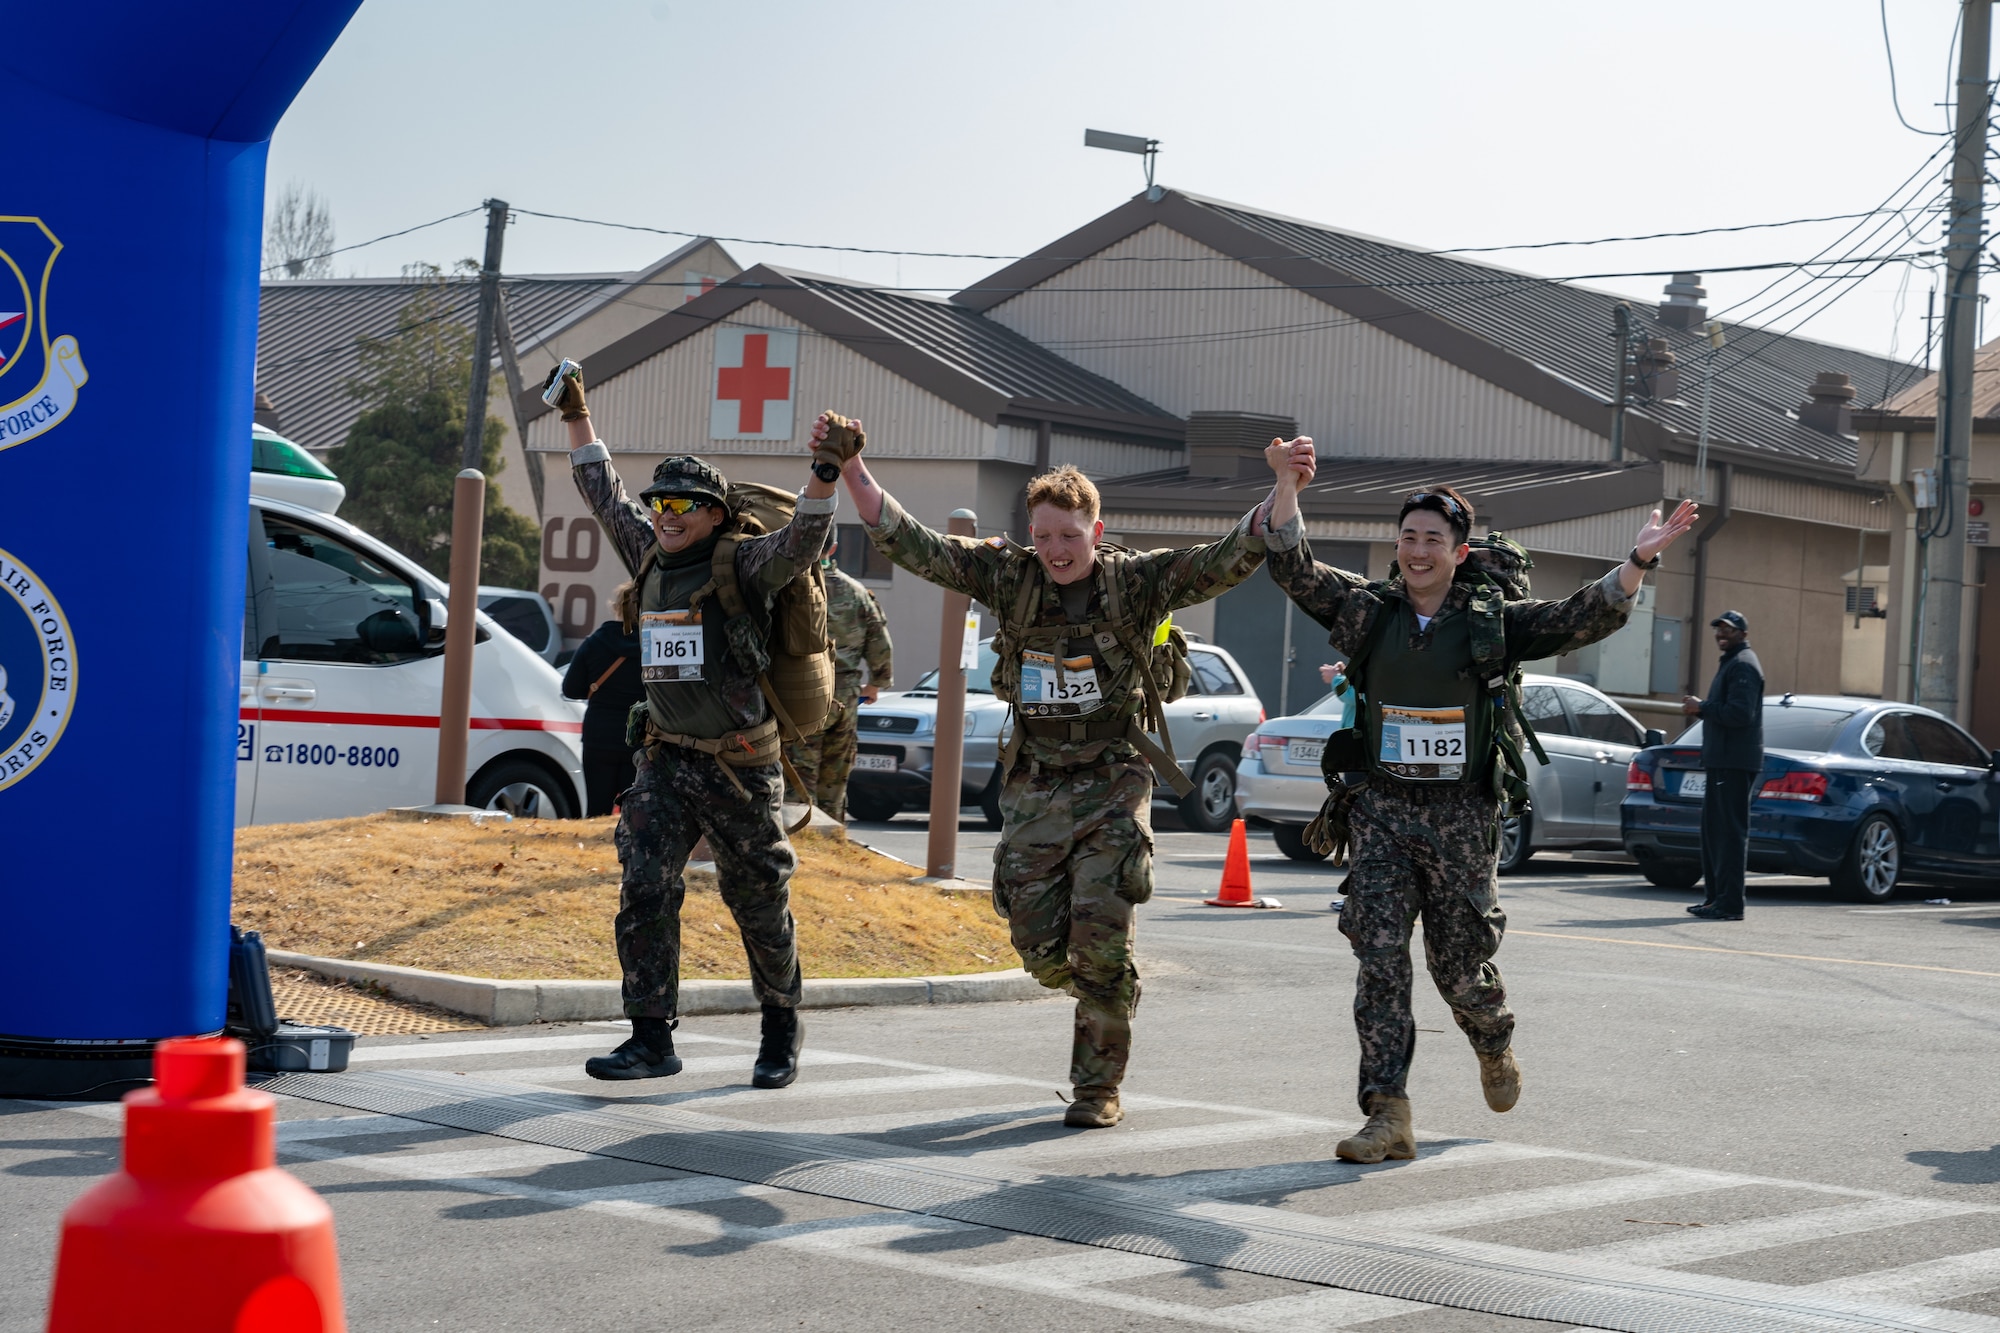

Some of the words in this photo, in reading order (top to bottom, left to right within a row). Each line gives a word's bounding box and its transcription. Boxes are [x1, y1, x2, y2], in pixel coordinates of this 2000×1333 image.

[0, 394, 60, 441] FORCE
[0, 559, 31, 597] IR
[31, 599, 68, 692] FORCE
[655, 640, 697, 658] 1861
[1023, 683, 1038, 691] 30K
[1048, 681, 1098, 699] 1522
[285, 743, 400, 768] 1800-8800
[1407, 738, 1463, 757] 1182
